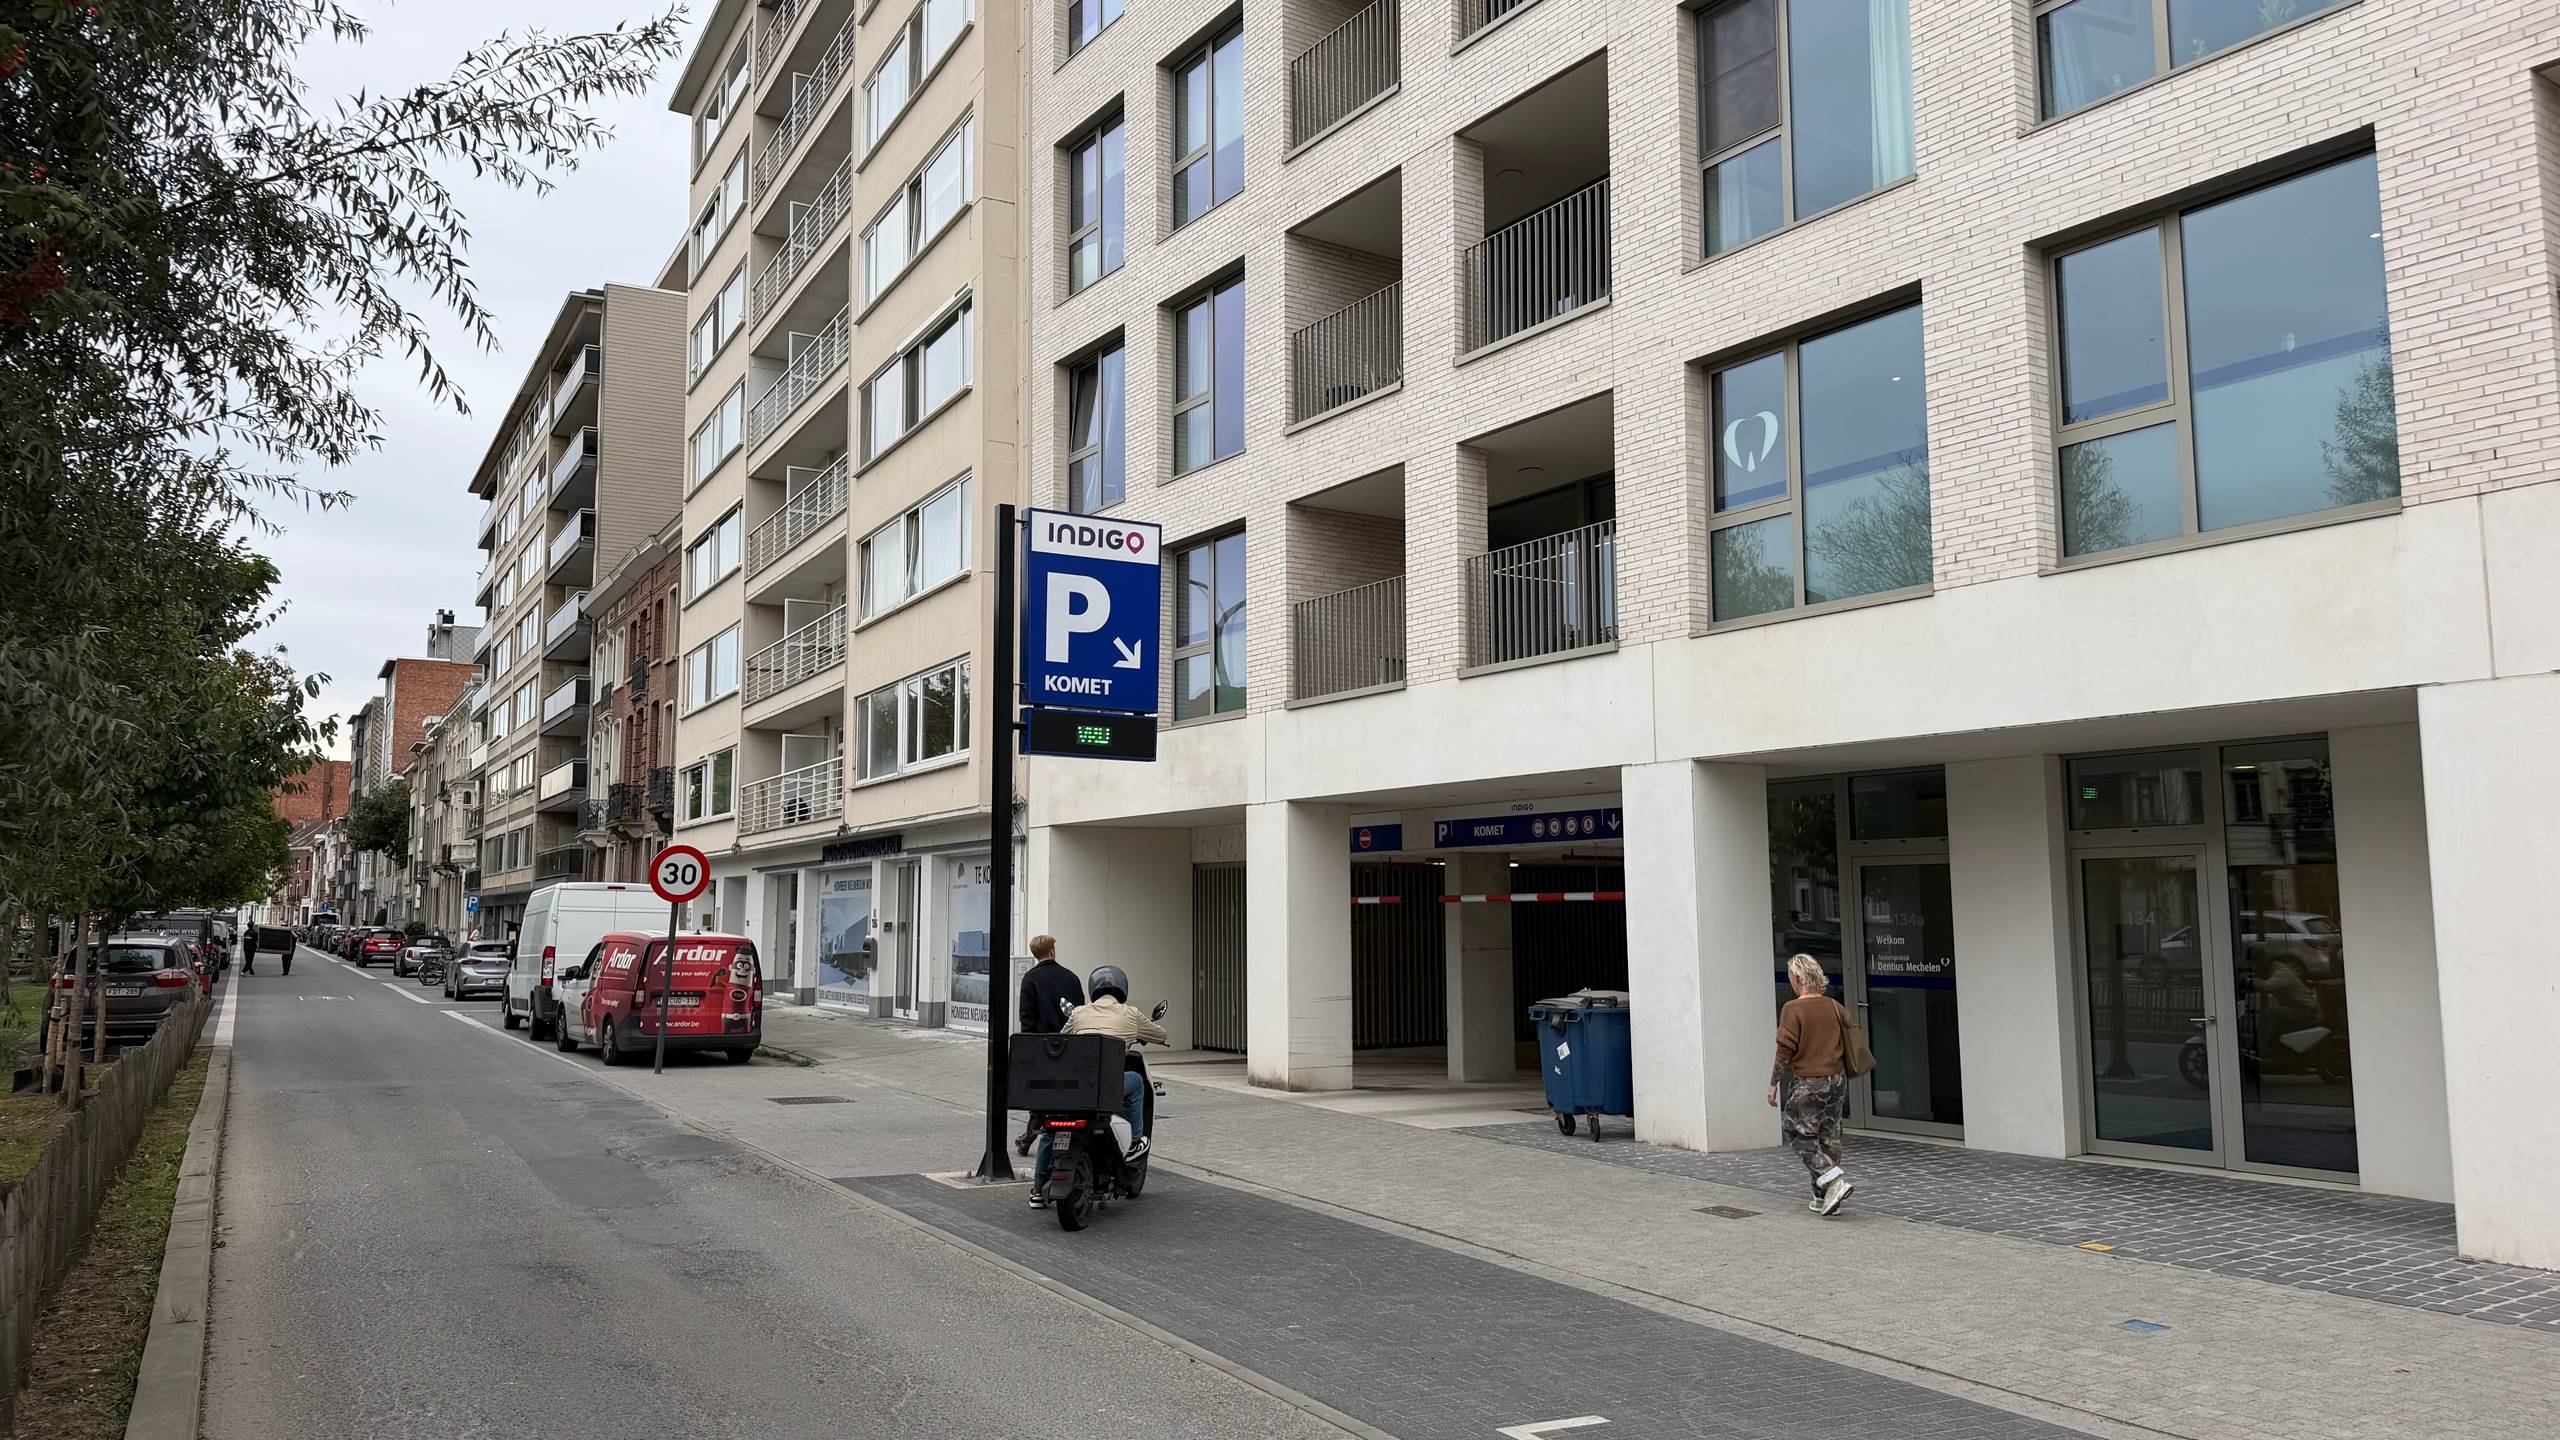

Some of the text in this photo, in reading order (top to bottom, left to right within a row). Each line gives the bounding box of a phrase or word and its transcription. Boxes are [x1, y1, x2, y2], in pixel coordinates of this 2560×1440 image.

[1048, 522, 1145, 554] INDIGO
[1045, 571, 1111, 664] P
[1044, 674, 1112, 695] KOMET
[1511, 803, 1534, 812] INDIGO
[1438, 823, 1448, 842] P
[1474, 825, 1505, 837] KOMET
[662, 862, 697, 886] 30
[468, 896, 478, 908] P
[1894, 913, 1925, 926] 134a
[2127, 911, 2156, 926] 134
[1876, 935, 1905, 945] Welkom
[605, 948, 636, 972] Ardor
[1877, 961, 1941, 973] Dentius Mechelen
[655, 1019, 700, 1028] ww.ardor.be
